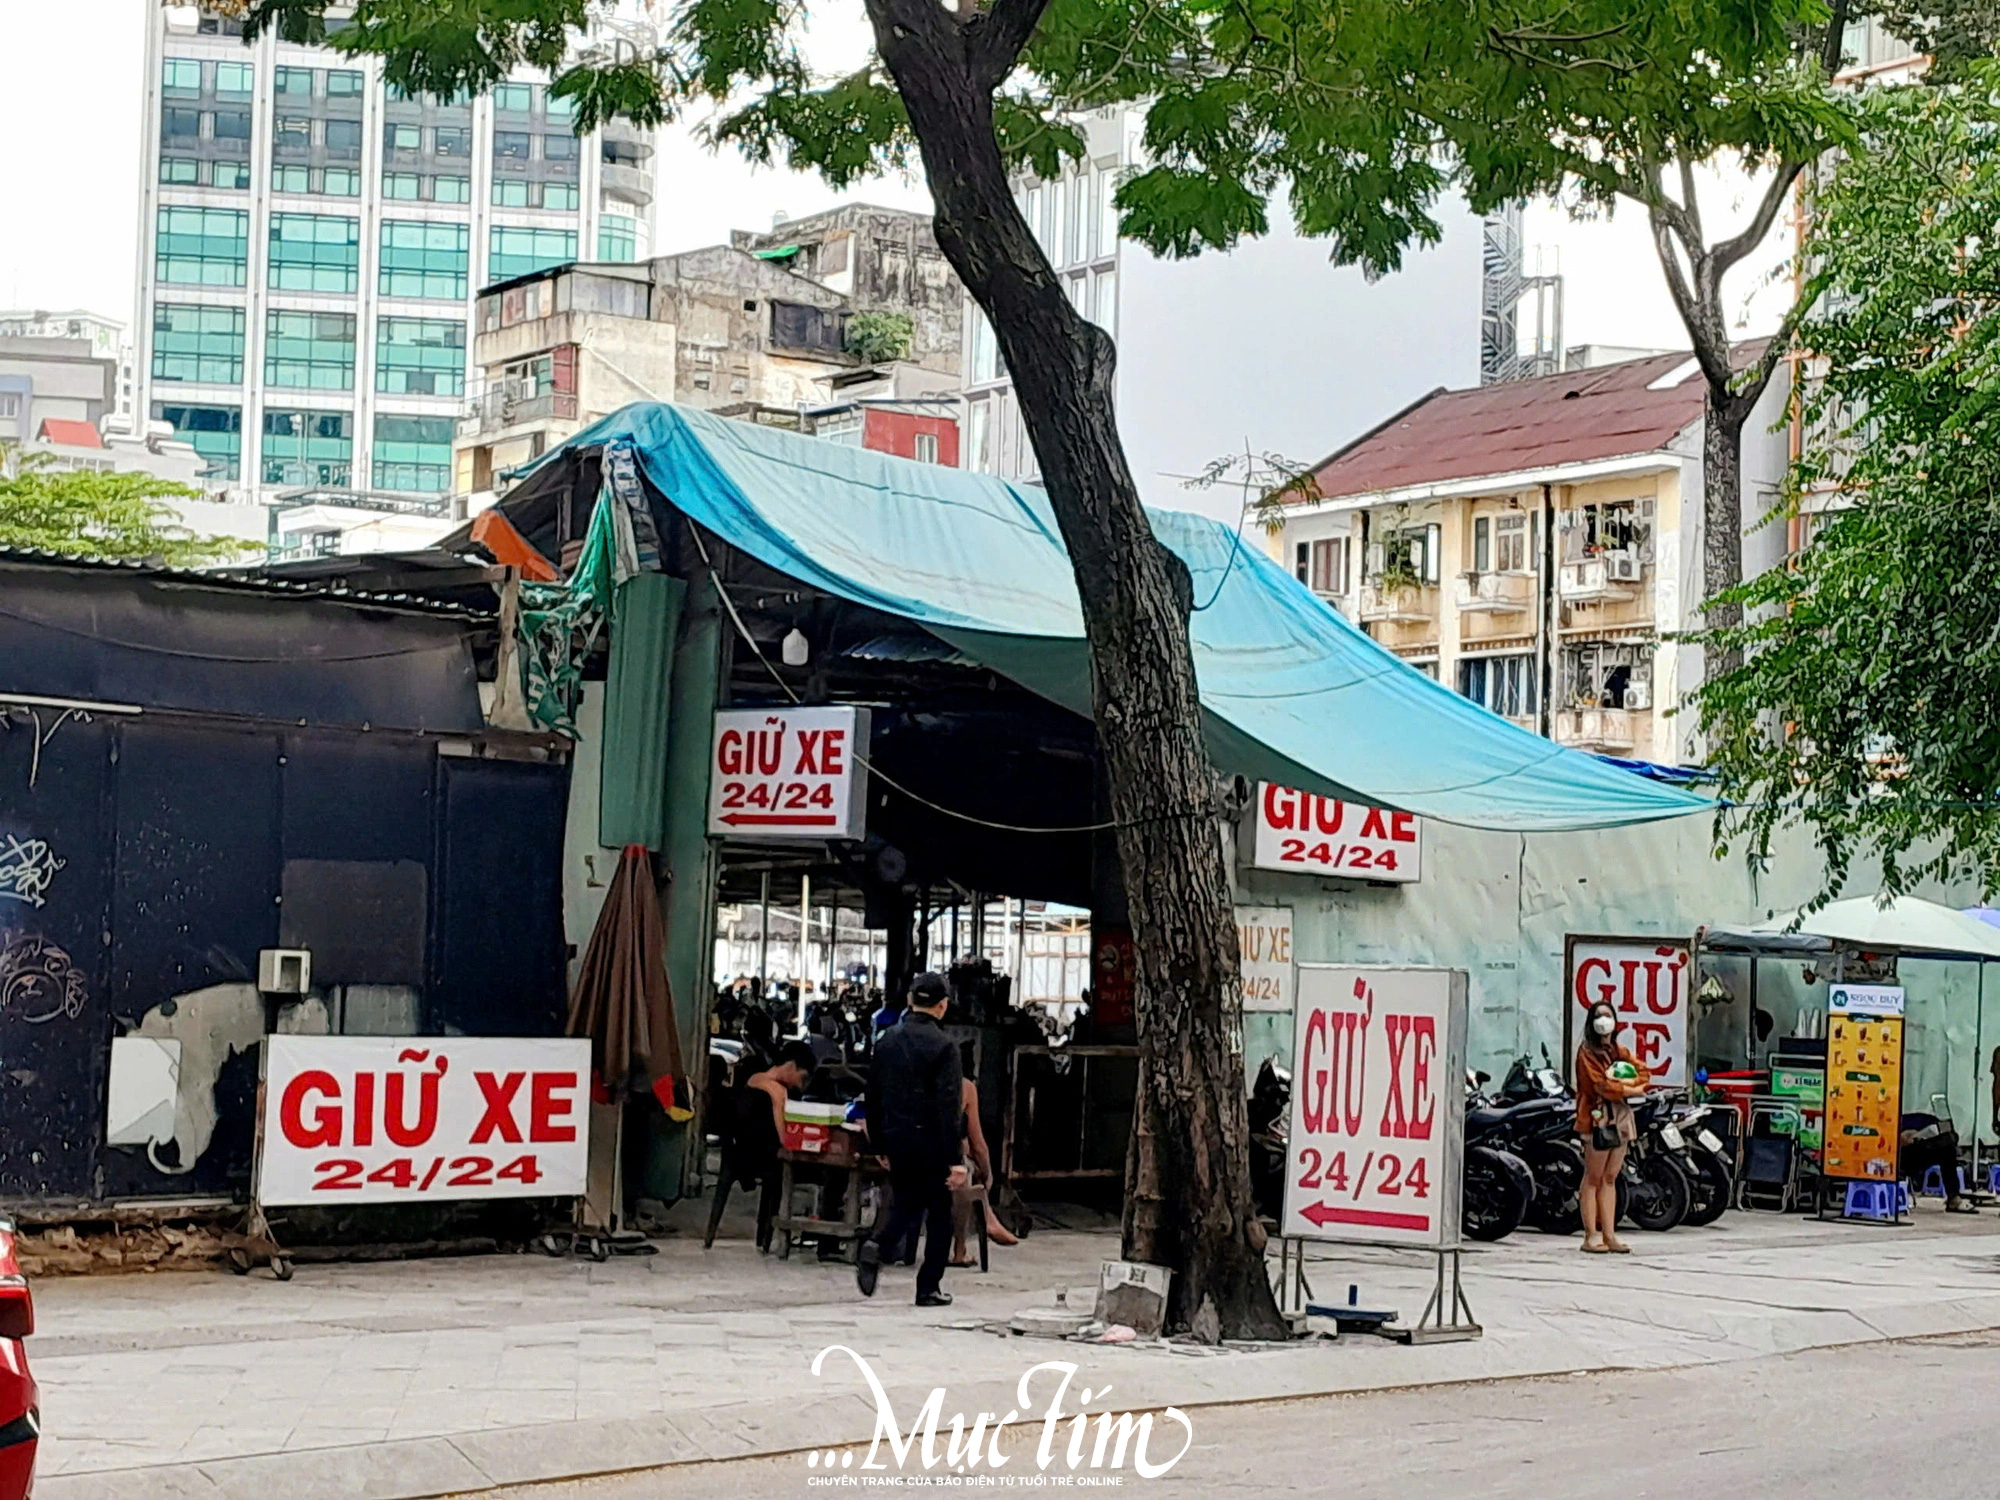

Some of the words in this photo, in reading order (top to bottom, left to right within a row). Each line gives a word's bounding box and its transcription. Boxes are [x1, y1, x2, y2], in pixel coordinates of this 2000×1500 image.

[718, 716, 786, 775] GIỮ
[794, 729, 845, 775] XE
[722, 782, 834, 811] 24/24
[1280, 838, 1398, 871] 24/24
[1268, 926, 1290, 963] XE
[1575, 946, 1688, 1015] GIỮ
[280, 1048, 449, 1149] GIỮ
[470, 1071, 578, 1145] XE
[1379, 1014, 1436, 1140] XE
[311, 1154, 544, 1191] 24/24
[1298, 1148, 1431, 1200] 24/24
